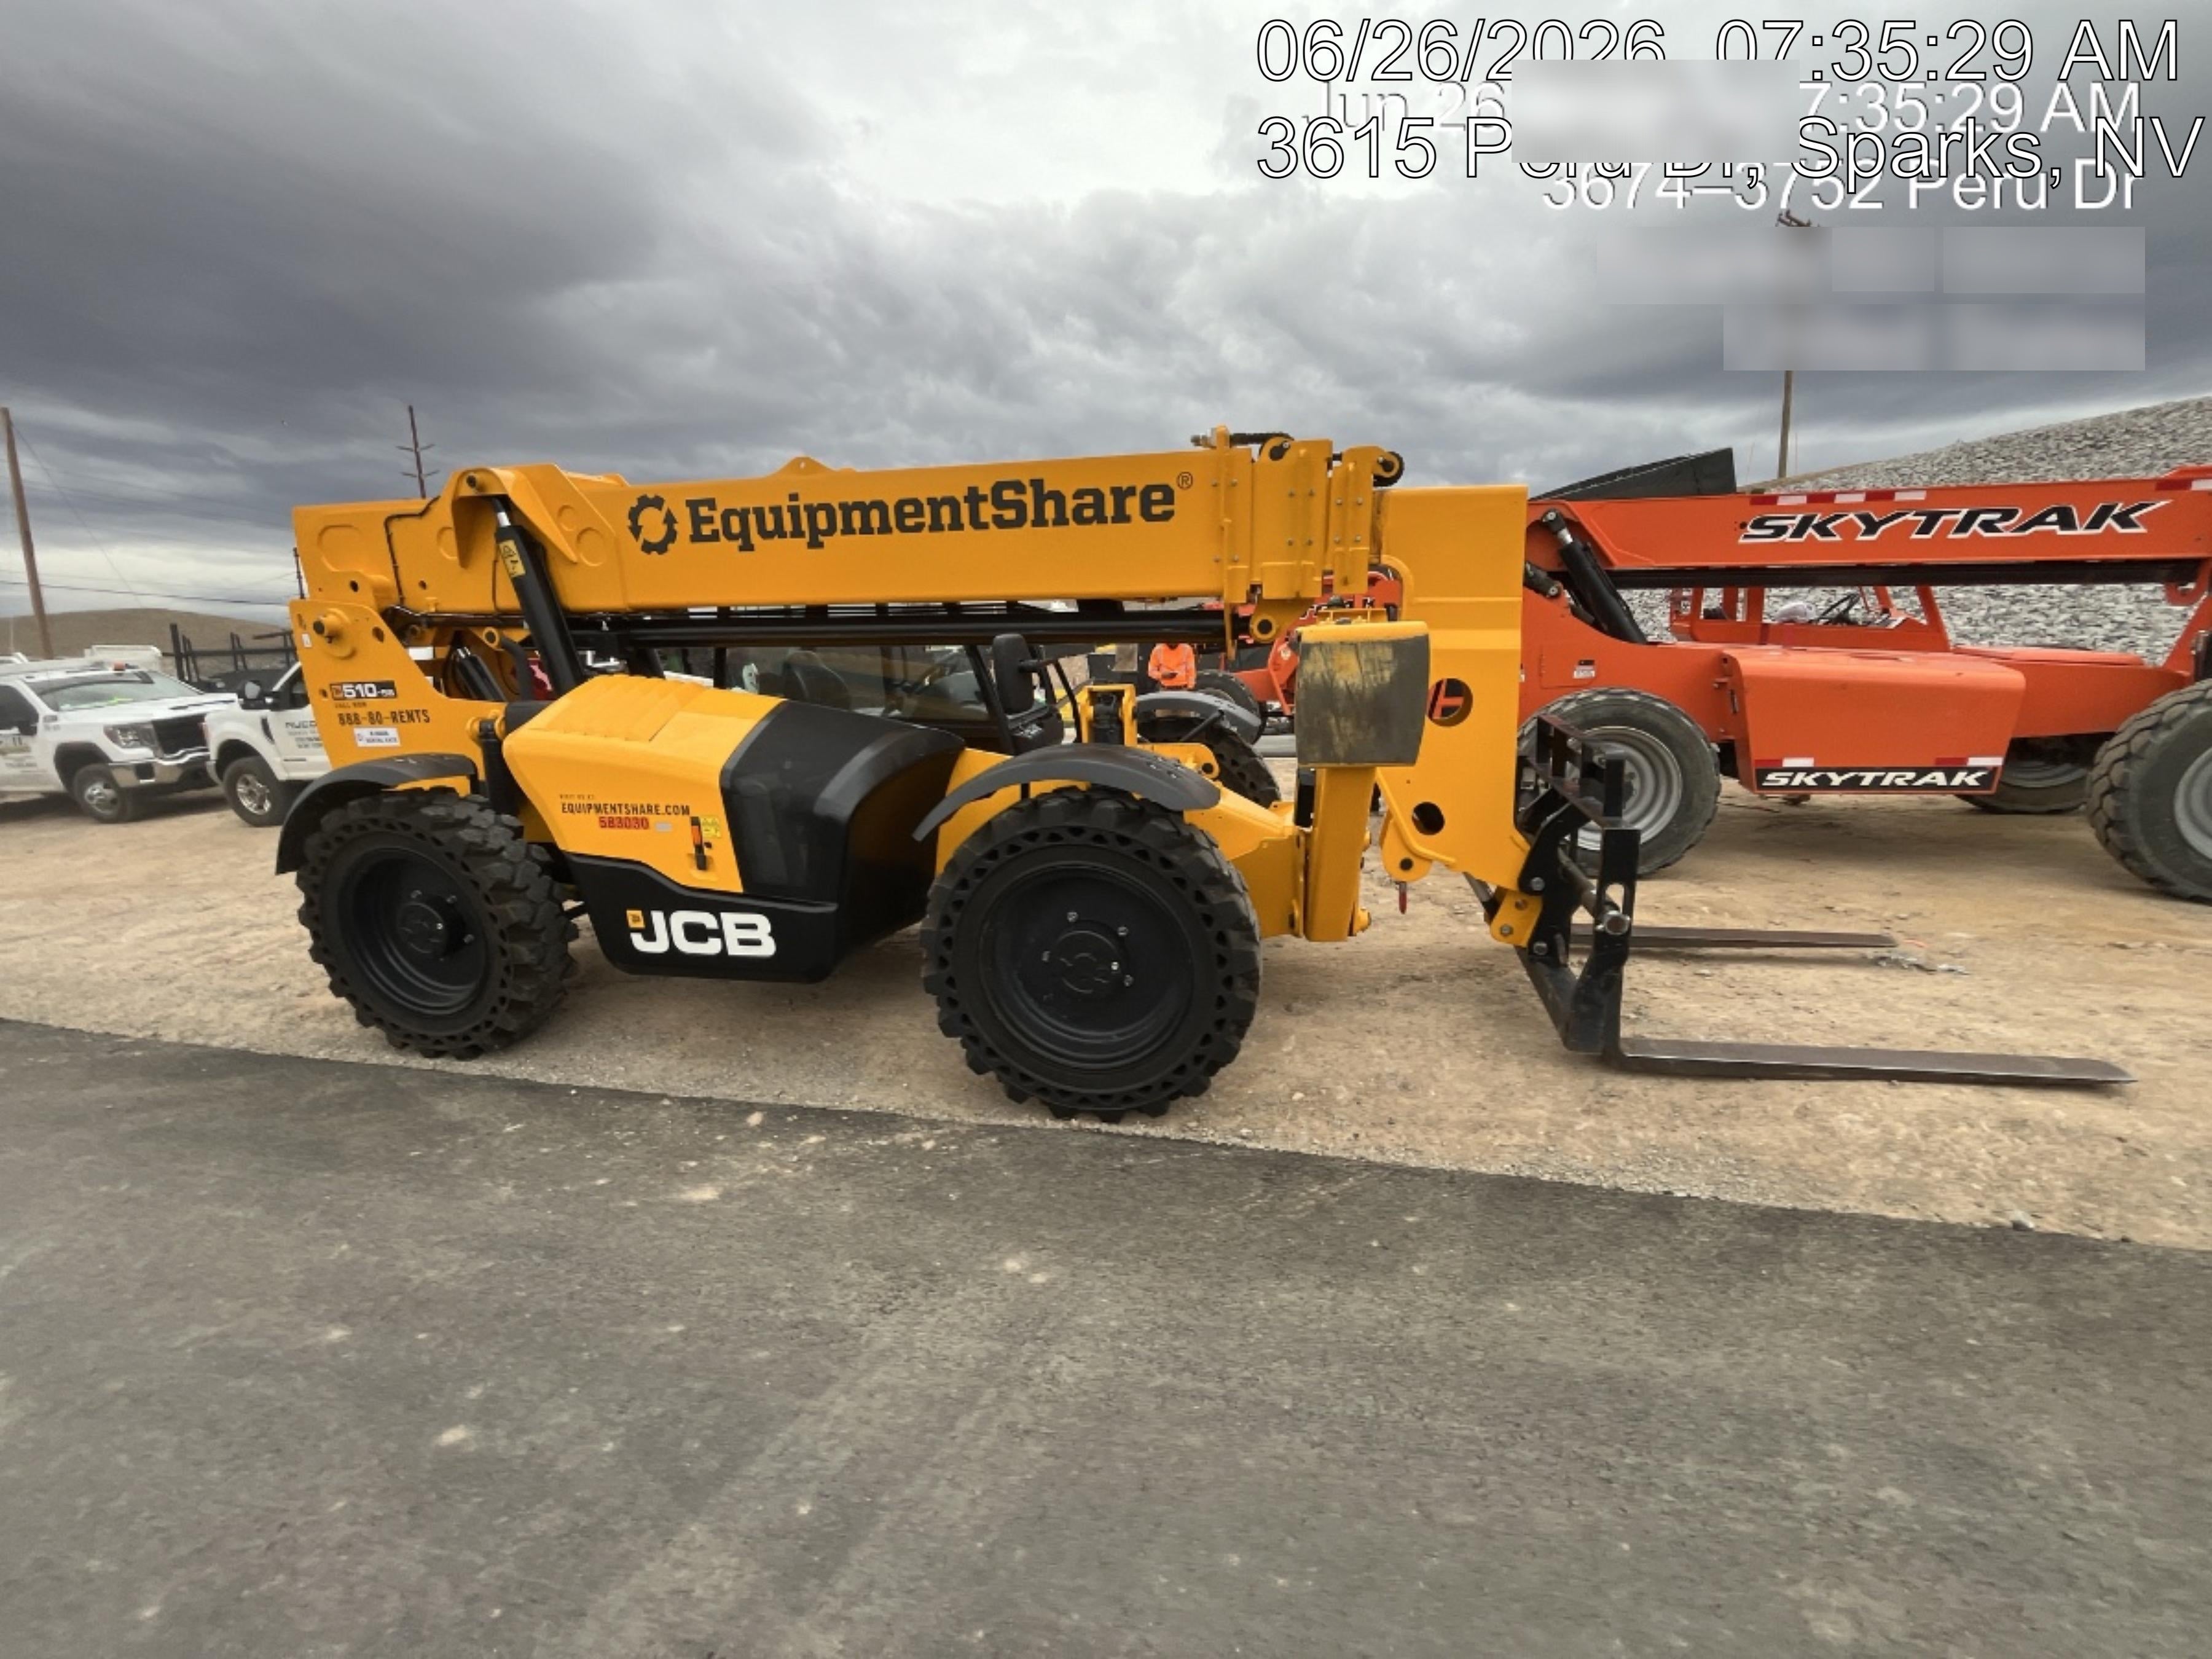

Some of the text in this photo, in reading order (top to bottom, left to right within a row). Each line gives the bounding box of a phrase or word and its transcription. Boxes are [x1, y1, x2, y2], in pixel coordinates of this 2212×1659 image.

[1739, 500, 2173, 544] SKYTRAK
[338, 709, 430, 725] 888-80-RENTS
[1762, 771, 1988, 786] SKYTRAK
[562, 802, 690, 815] EQUIPMENTSHARE.COM
[598, 815, 649, 830] 583030
[629, 910, 777, 957] JCB
